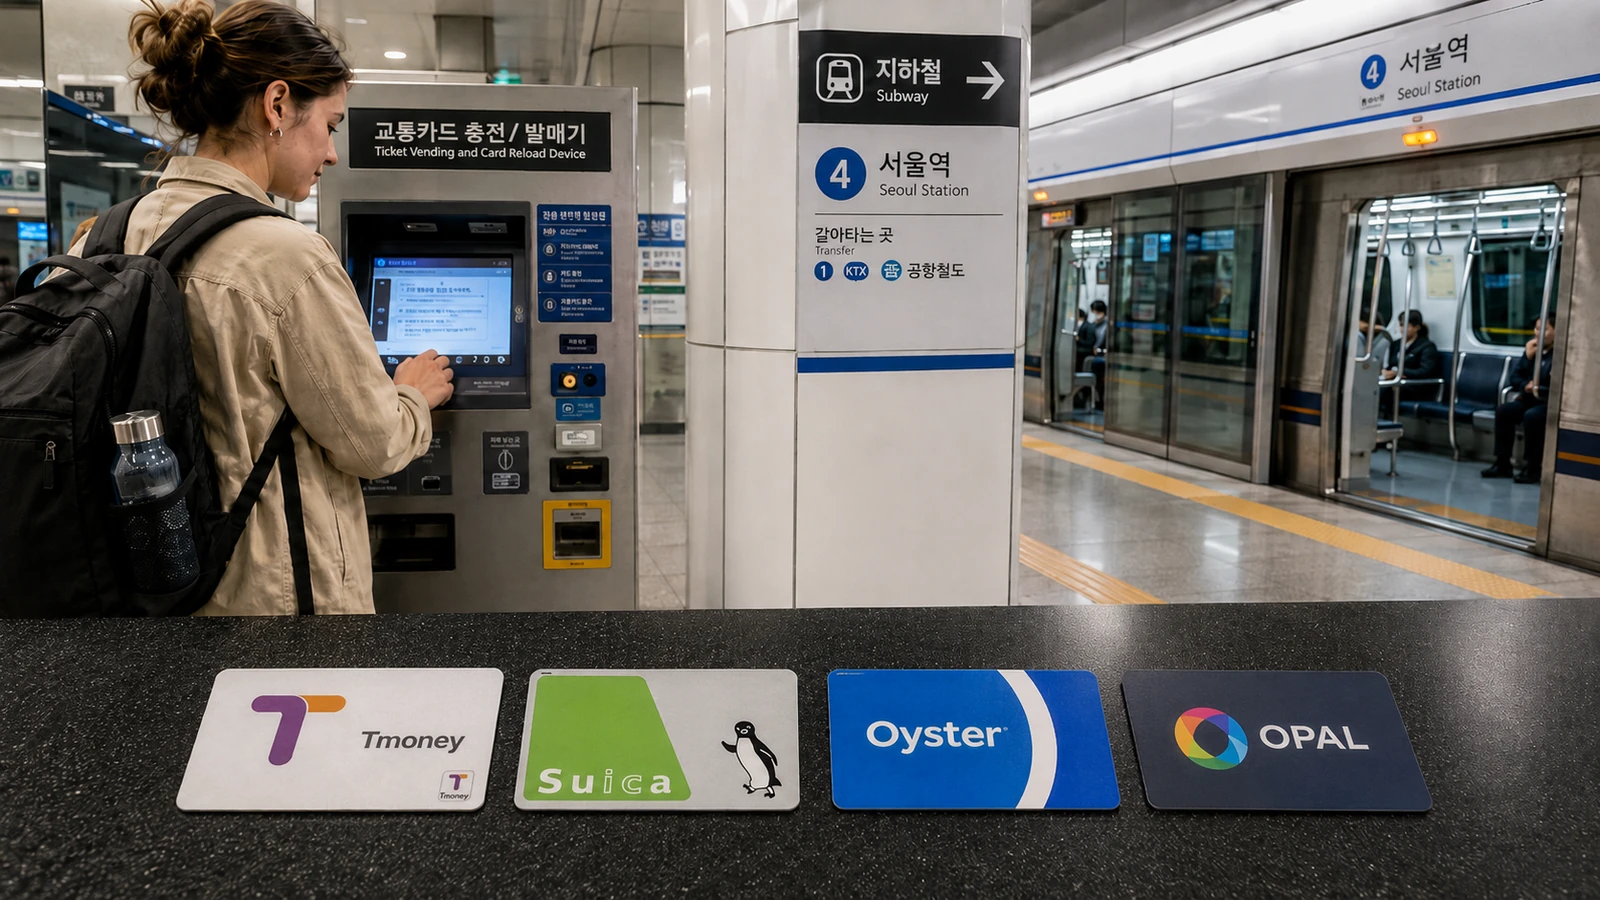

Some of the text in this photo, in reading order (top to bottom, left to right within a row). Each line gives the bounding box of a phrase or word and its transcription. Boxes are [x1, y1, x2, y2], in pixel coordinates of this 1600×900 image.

[876, 58, 940, 84] 지하철
[1366, 60, 1380, 83] 4
[877, 89, 928, 105] Subway
[1398, 75, 1480, 100] Seoul Station
[375, 122, 458, 142] 교통카드
[526, 123, 584, 144] 발매기
[375, 146, 586, 160] Ticket Vending and Card Reload Device
[830, 159, 851, 189] 4
[880, 152, 949, 178] 서울역
[880, 184, 969, 197] Seoul Station
[816, 227, 893, 243] 갈아타는 곳
[816, 246, 855, 256] Transfer
[845, 266, 868, 277] KTX
[908, 263, 964, 278] 공항철도
[362, 731, 465, 753] Tmoney
[866, 720, 1002, 755] Oyster
[1260, 725, 1369, 749] OPAL
[538, 768, 671, 794] Suica
[440, 791, 469, 801] Tmoney
